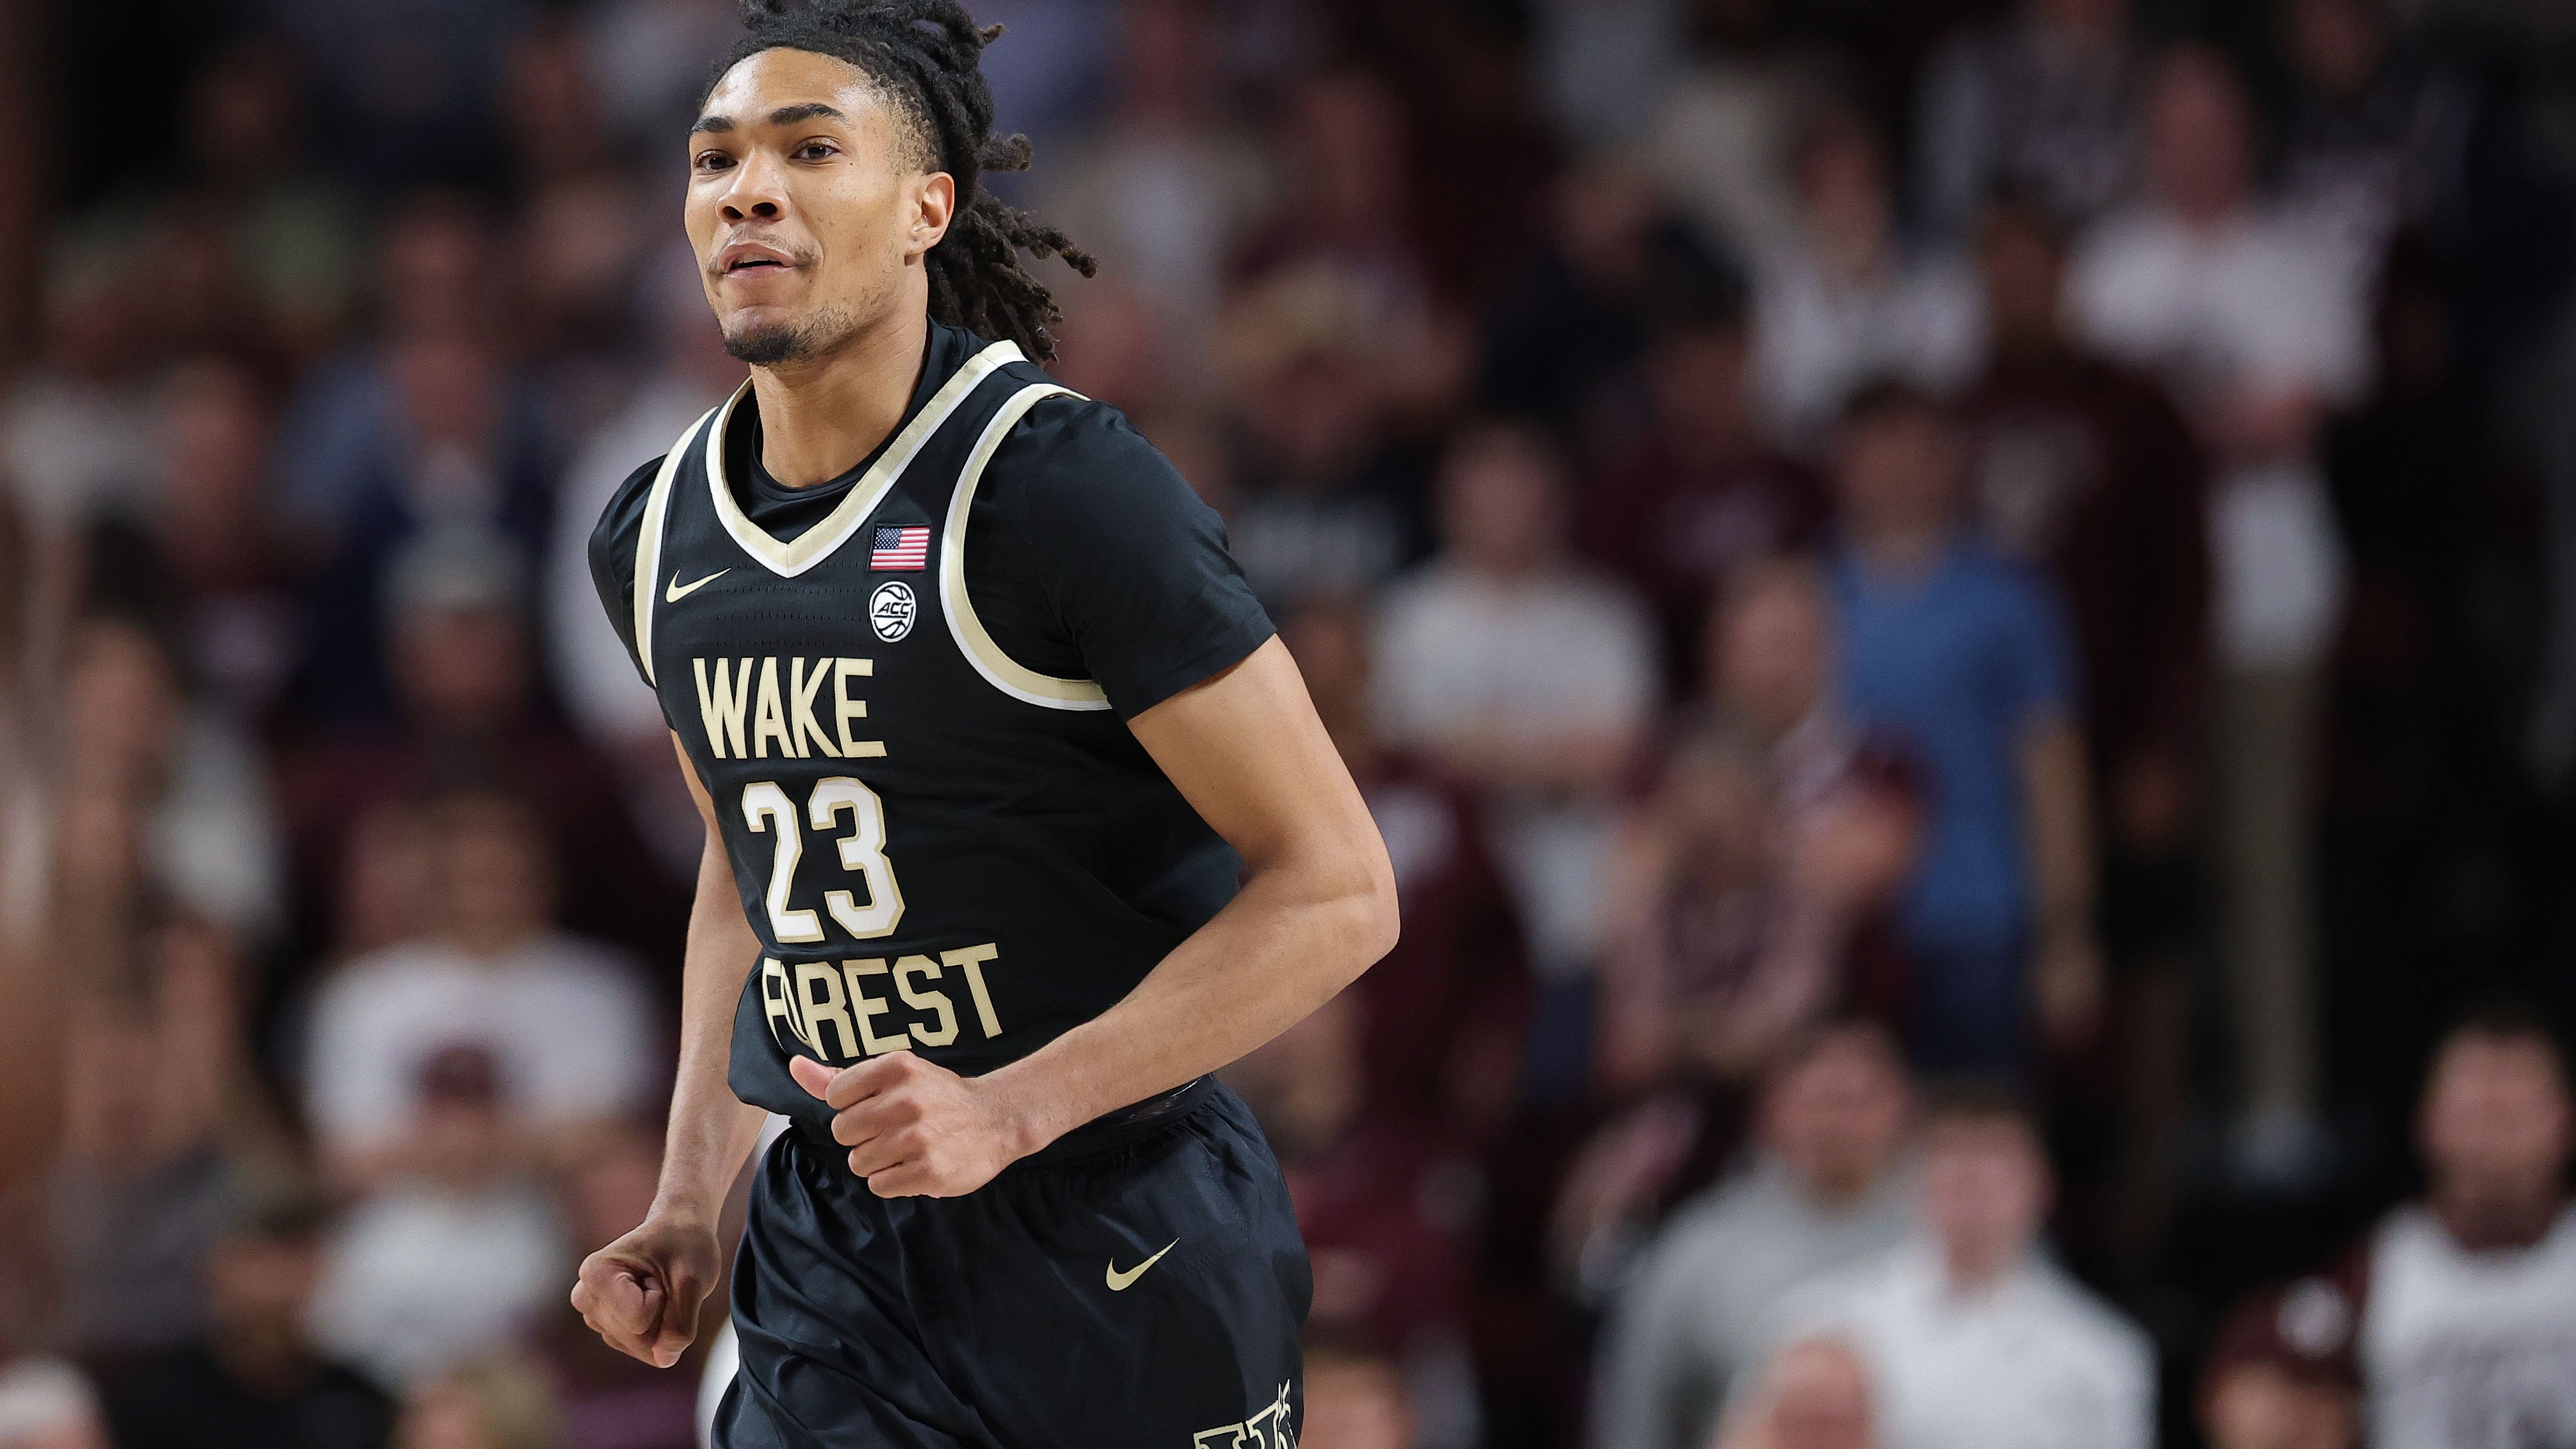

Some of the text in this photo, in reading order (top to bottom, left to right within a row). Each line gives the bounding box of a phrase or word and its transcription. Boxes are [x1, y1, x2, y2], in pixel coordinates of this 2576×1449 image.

[877, 602, 913, 615] ACC
[692, 657, 888, 759] WAKE
[741, 776, 906, 943] 23
